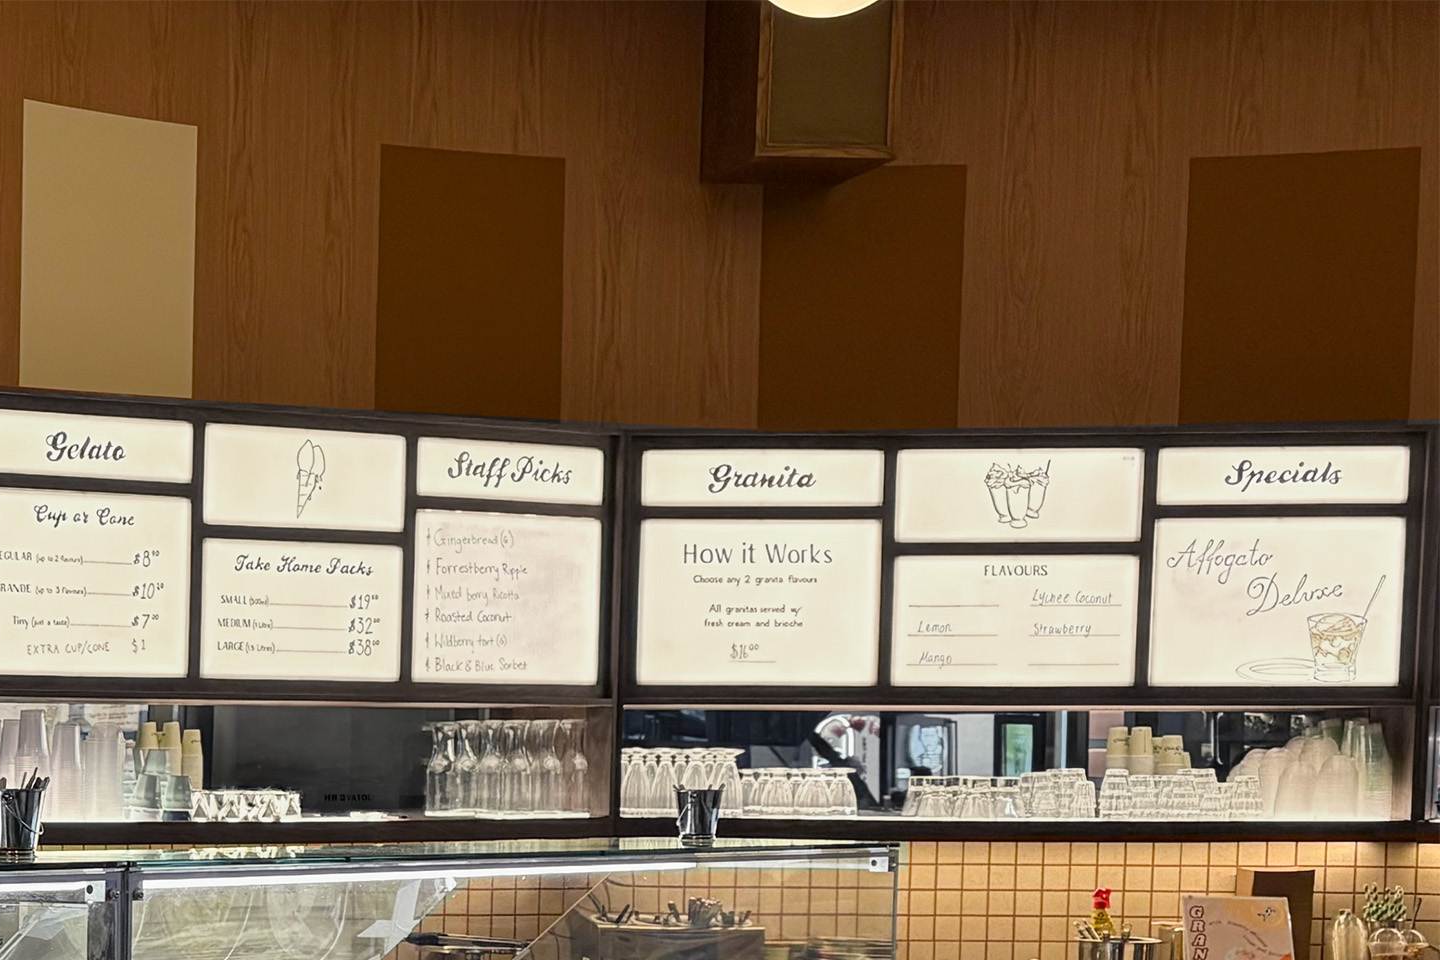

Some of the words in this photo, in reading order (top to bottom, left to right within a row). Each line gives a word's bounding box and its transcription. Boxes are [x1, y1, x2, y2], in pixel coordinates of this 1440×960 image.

[46, 431, 126, 462] Gelato
[447, 451, 510, 488] Staff
[511, 456, 573, 485] Picks
[707, 463, 816, 494] Granita
[1224, 459, 1343, 493] Specials
[33, 504, 68, 529] Cup
[73, 511, 89, 524] or
[96, 507, 135, 526] Cone
[433, 527, 498, 554] Gingerbread
[683, 543, 733, 564] How
[742, 541, 756, 564] it
[765, 543, 833, 564] Works
[1166, 538, 1274, 585] Affogato
[234, 554, 271, 572] Take
[276, 554, 322, 574] Home
[325, 557, 374, 577] Packs
[436, 557, 499, 580] Forrestberry
[983, 564, 1048, 577] FLAVOURS
[693, 574, 723, 584] Choose
[726, 576, 741, 587] any
[744, 574, 751, 584] 2
[755, 575, 784, 587] granita
[788, 574, 818, 584] flavours
[220, 594, 248, 605] SMALL
[434, 585, 462, 601] Mixed
[492, 588, 520, 601] Ricotta
[1031, 588, 1069, 606] Lychee
[1075, 590, 1113, 605] Coconut
[1246, 571, 1343, 617] Deluxe
[435, 608, 473, 623] Roasted
[476, 610, 512, 623] Coconut
[708, 603, 722, 614] All
[725, 605, 758, 616] granitas
[760, 604, 786, 614] served
[217, 618, 251, 629] MEDIUM
[704, 618, 724, 628] fresh
[727, 619, 751, 628] cream
[755, 619, 770, 628] and
[774, 619, 803, 628] brioche
[917, 620, 953, 634] Lemon
[1034, 622, 1092, 638] Strawberry
[27, 644, 60, 656] EXTRA
[64, 640, 110, 656] CUP/CONE
[131, 638, 147, 655] $1
[217, 641, 244, 652] LARGE
[435, 656, 463, 672] Black
[919, 651, 953, 669] Mango
